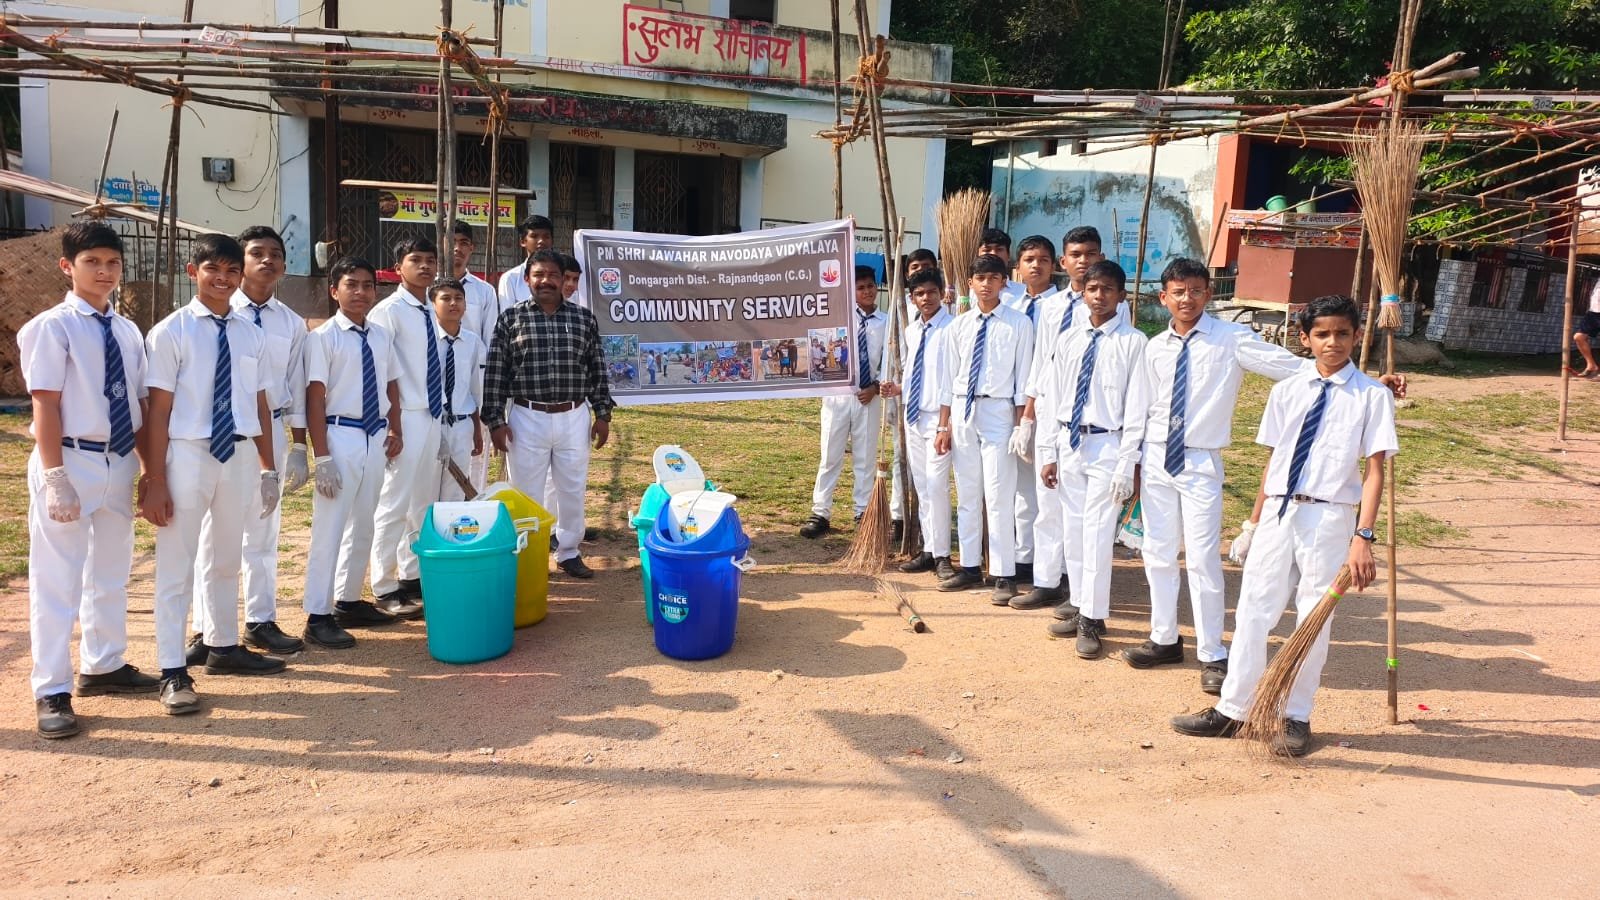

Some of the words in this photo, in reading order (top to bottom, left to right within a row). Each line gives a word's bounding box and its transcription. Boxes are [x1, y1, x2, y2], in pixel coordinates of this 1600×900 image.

[634, 16, 704, 64] सुलभ
[597, 247, 614, 261] PM
[617, 247, 645, 260] SHRI
[649, 249, 707, 262] JAWAHAR
[711, 247, 773, 261] NAVODAYA
[776, 239, 839, 256] VIDYALAYA
[629, 275, 684, 287] Dongargarh
[687, 275, 710, 285] Dist.
[718, 272, 782, 286] Rajnandgaon
[785, 269, 812, 283] (C.G.)
[609, 298, 736, 323] COMMUNITY
[742, 292, 829, 320] SERVICE
[659, 593, 687, 604] CHOICE
